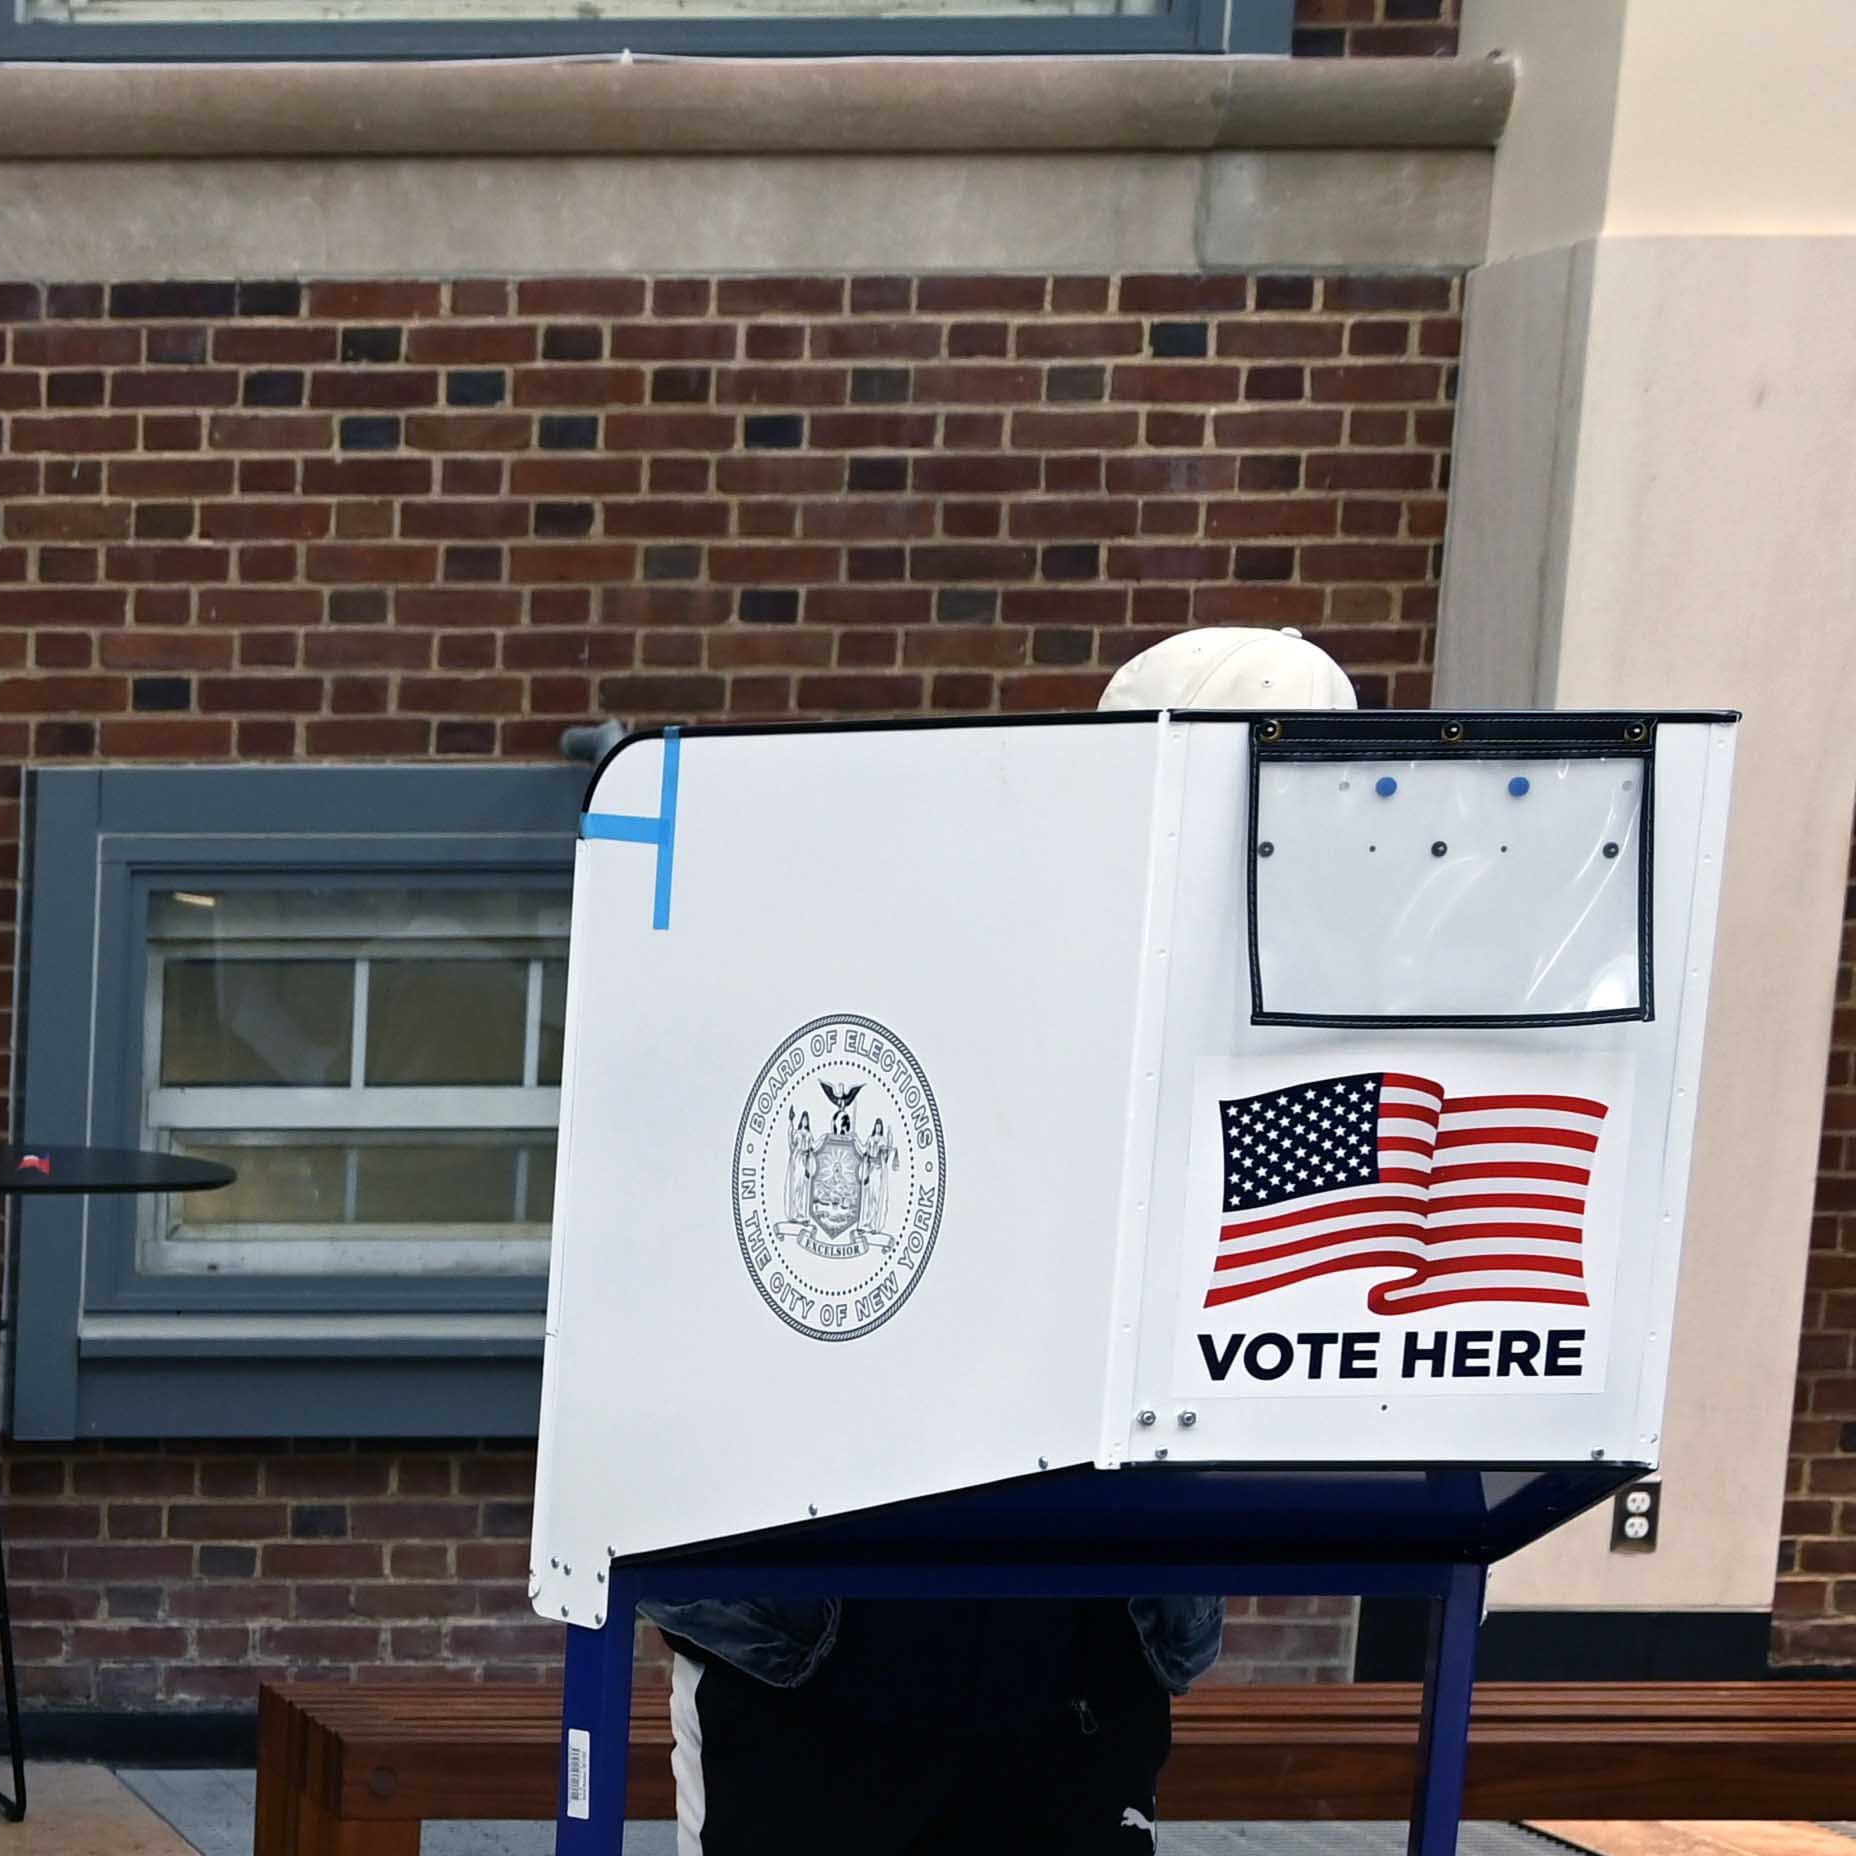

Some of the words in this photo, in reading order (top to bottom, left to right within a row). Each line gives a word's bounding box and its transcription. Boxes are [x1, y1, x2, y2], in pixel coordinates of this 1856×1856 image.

[749, 1047, 805, 1135] BOARD
[810, 1029, 838, 1057] OF
[844, 1029, 933, 1149] ELECTIONS
[742, 1168, 756, 1200] IN
[745, 1209, 772, 1271] THE
[805, 1237, 861, 1256] EXCELSIOR
[897, 1184, 936, 1270] YORK
[769, 1272, 815, 1320] CITY
[820, 1304, 848, 1327] OF
[854, 1270, 899, 1322] NEW
[1197, 1331, 1382, 1382] VOTE
[1400, 1328, 1587, 1379] HERE
